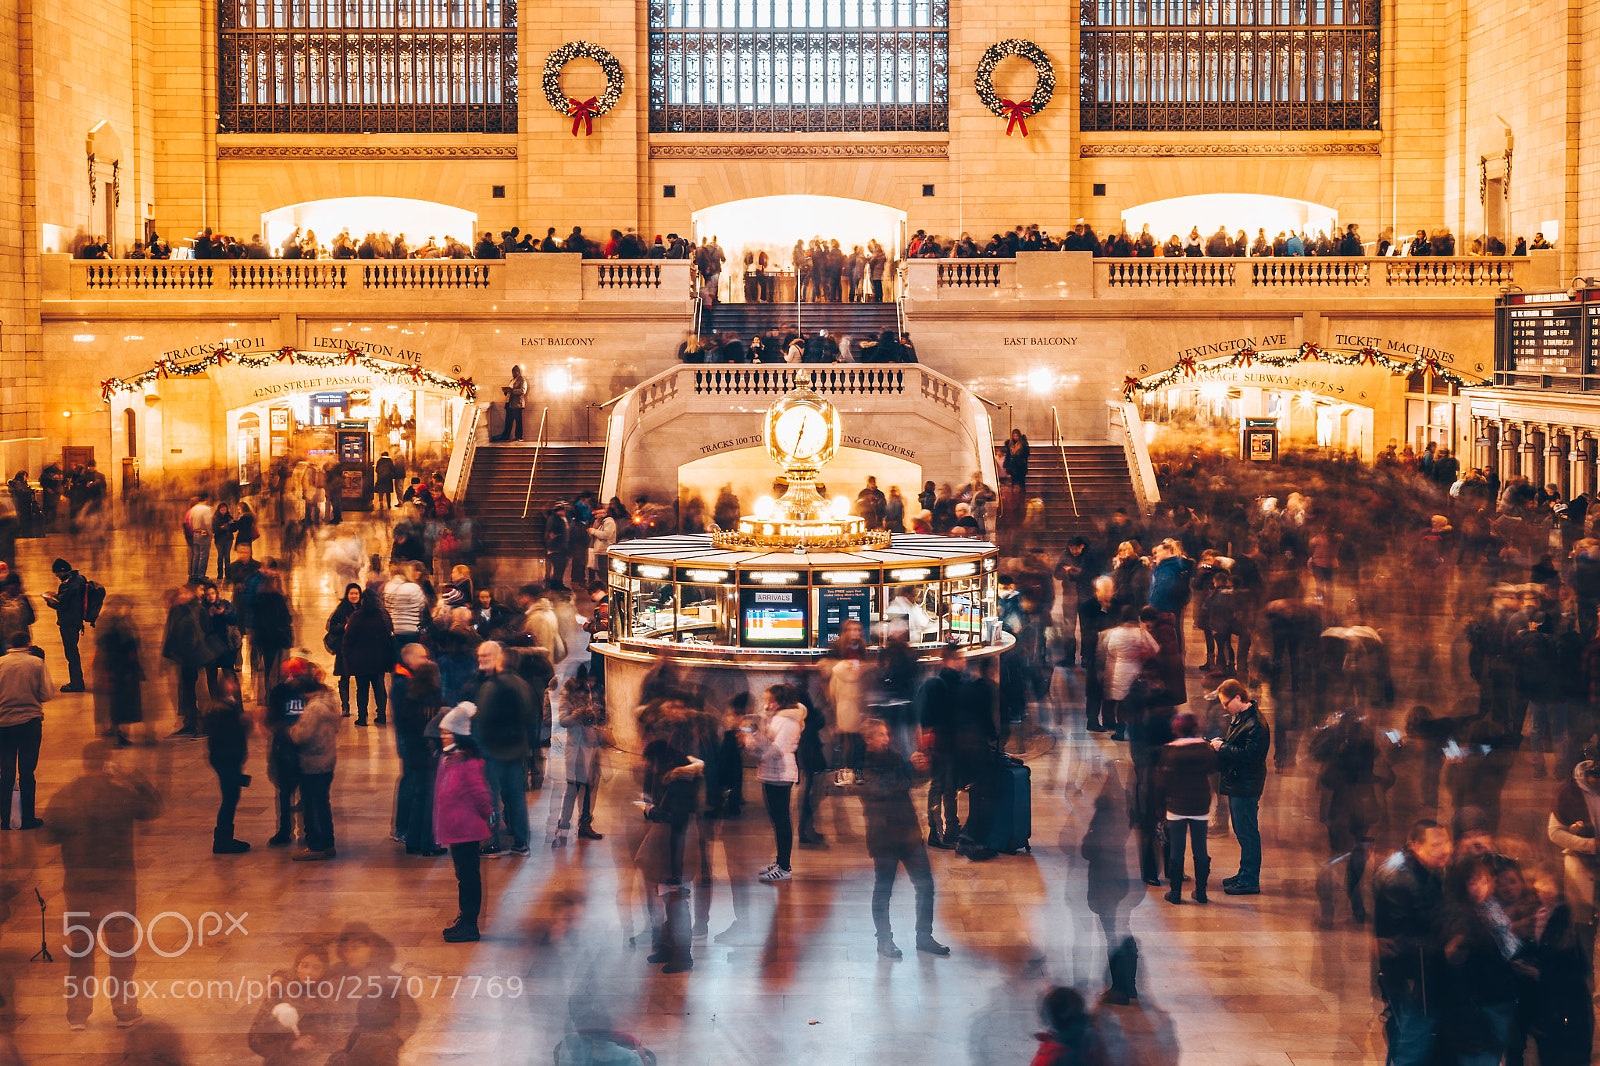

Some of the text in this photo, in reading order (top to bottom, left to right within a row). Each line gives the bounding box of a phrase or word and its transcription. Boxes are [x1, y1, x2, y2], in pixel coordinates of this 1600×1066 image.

[164, 343, 215, 361] TRACKS
[234, 338, 252, 349] TO
[314, 337, 422, 363] LEXINGTON AVE
[521, 338, 595, 346] EAST BALCONY
[1004, 337, 1078, 346] EAST BALCONY
[1177, 335, 1286, 359] LEXINGTON AVE
[1336, 334, 1455, 364] TICKET MACHINES
[253, 385, 281, 397] 42ND
[283, 378, 323, 391] STREET
[326, 375, 372, 386] PASSAGE
[1244, 373, 1292, 385] SUBWAY
[700, 440, 734, 454] TRACKS
[735, 437, 748, 446] 100
[749, 434, 762, 444] TO
[862, 438, 915, 459] CONCOURSE
